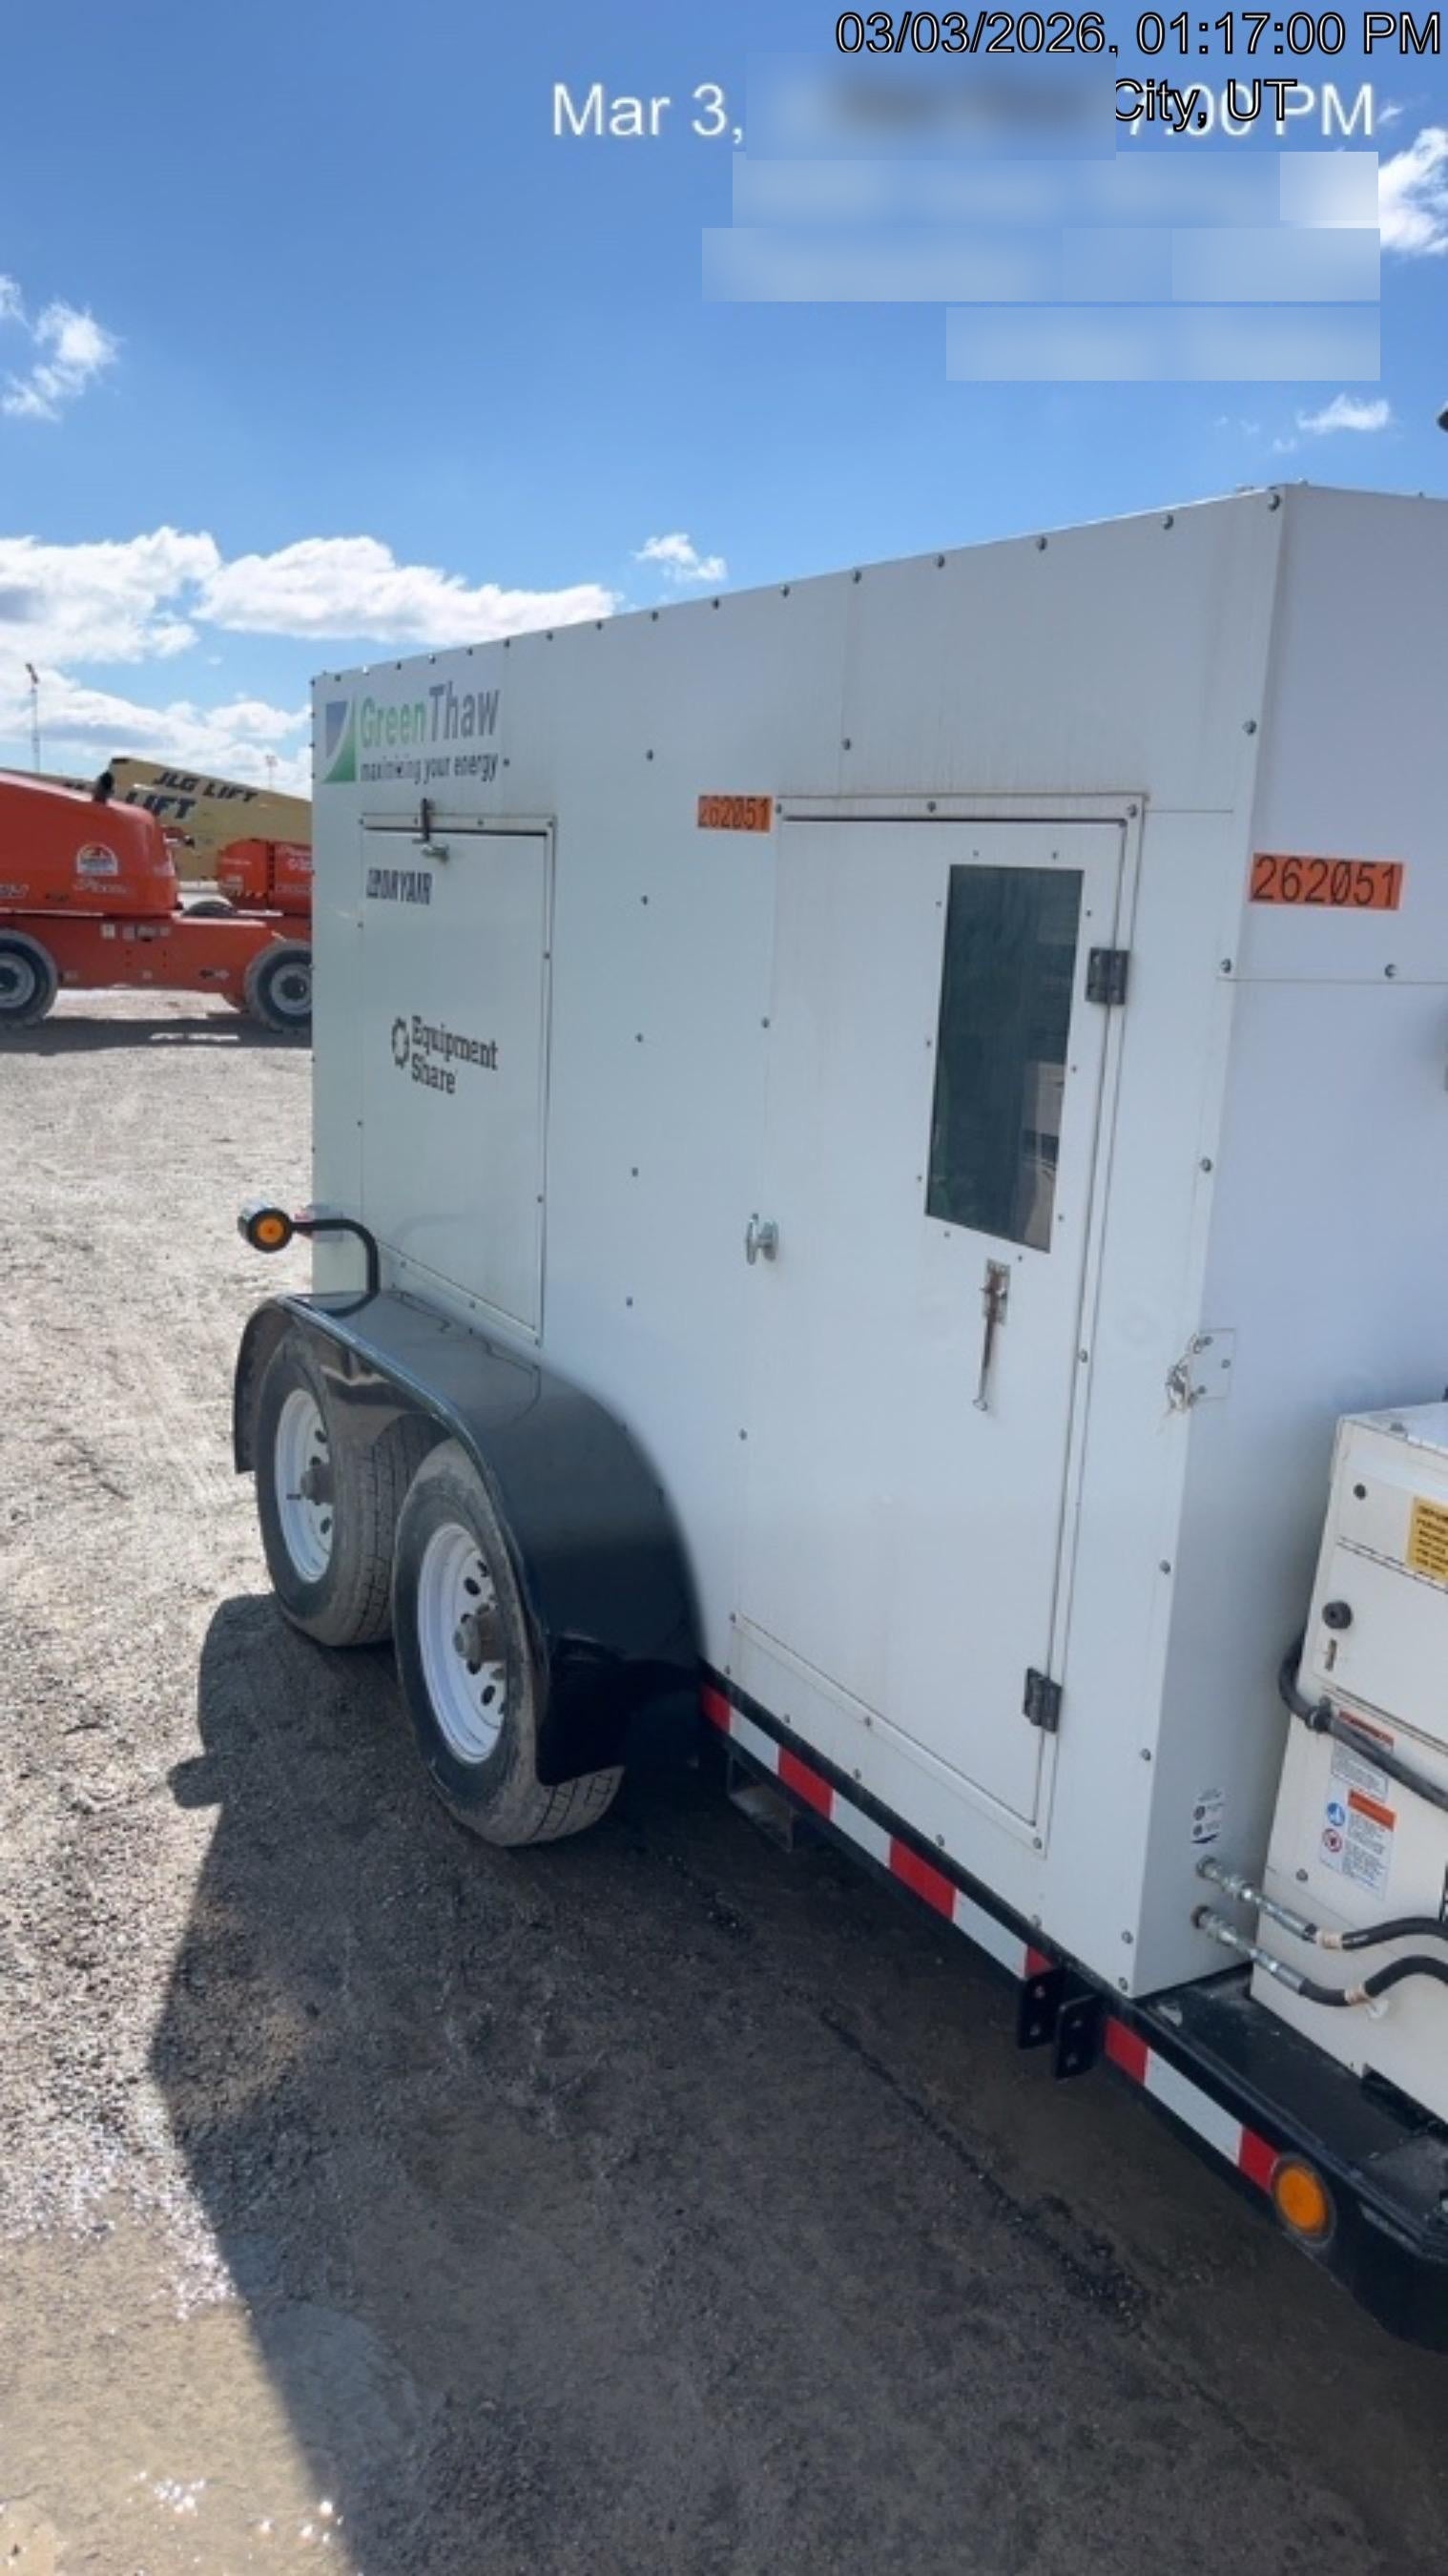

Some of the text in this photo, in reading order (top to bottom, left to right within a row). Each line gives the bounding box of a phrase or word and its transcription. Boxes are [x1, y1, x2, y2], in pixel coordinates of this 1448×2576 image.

[359, 680, 500, 750] GreenThaw
[153, 771, 258, 802] JLG LIFT
[423, 758, 450, 784] your
[454, 753, 498, 782] energy
[1252, 855, 1396, 905] 262051
[411, 1015, 498, 1070] Equipment
[411, 1052, 456, 1094] Share
